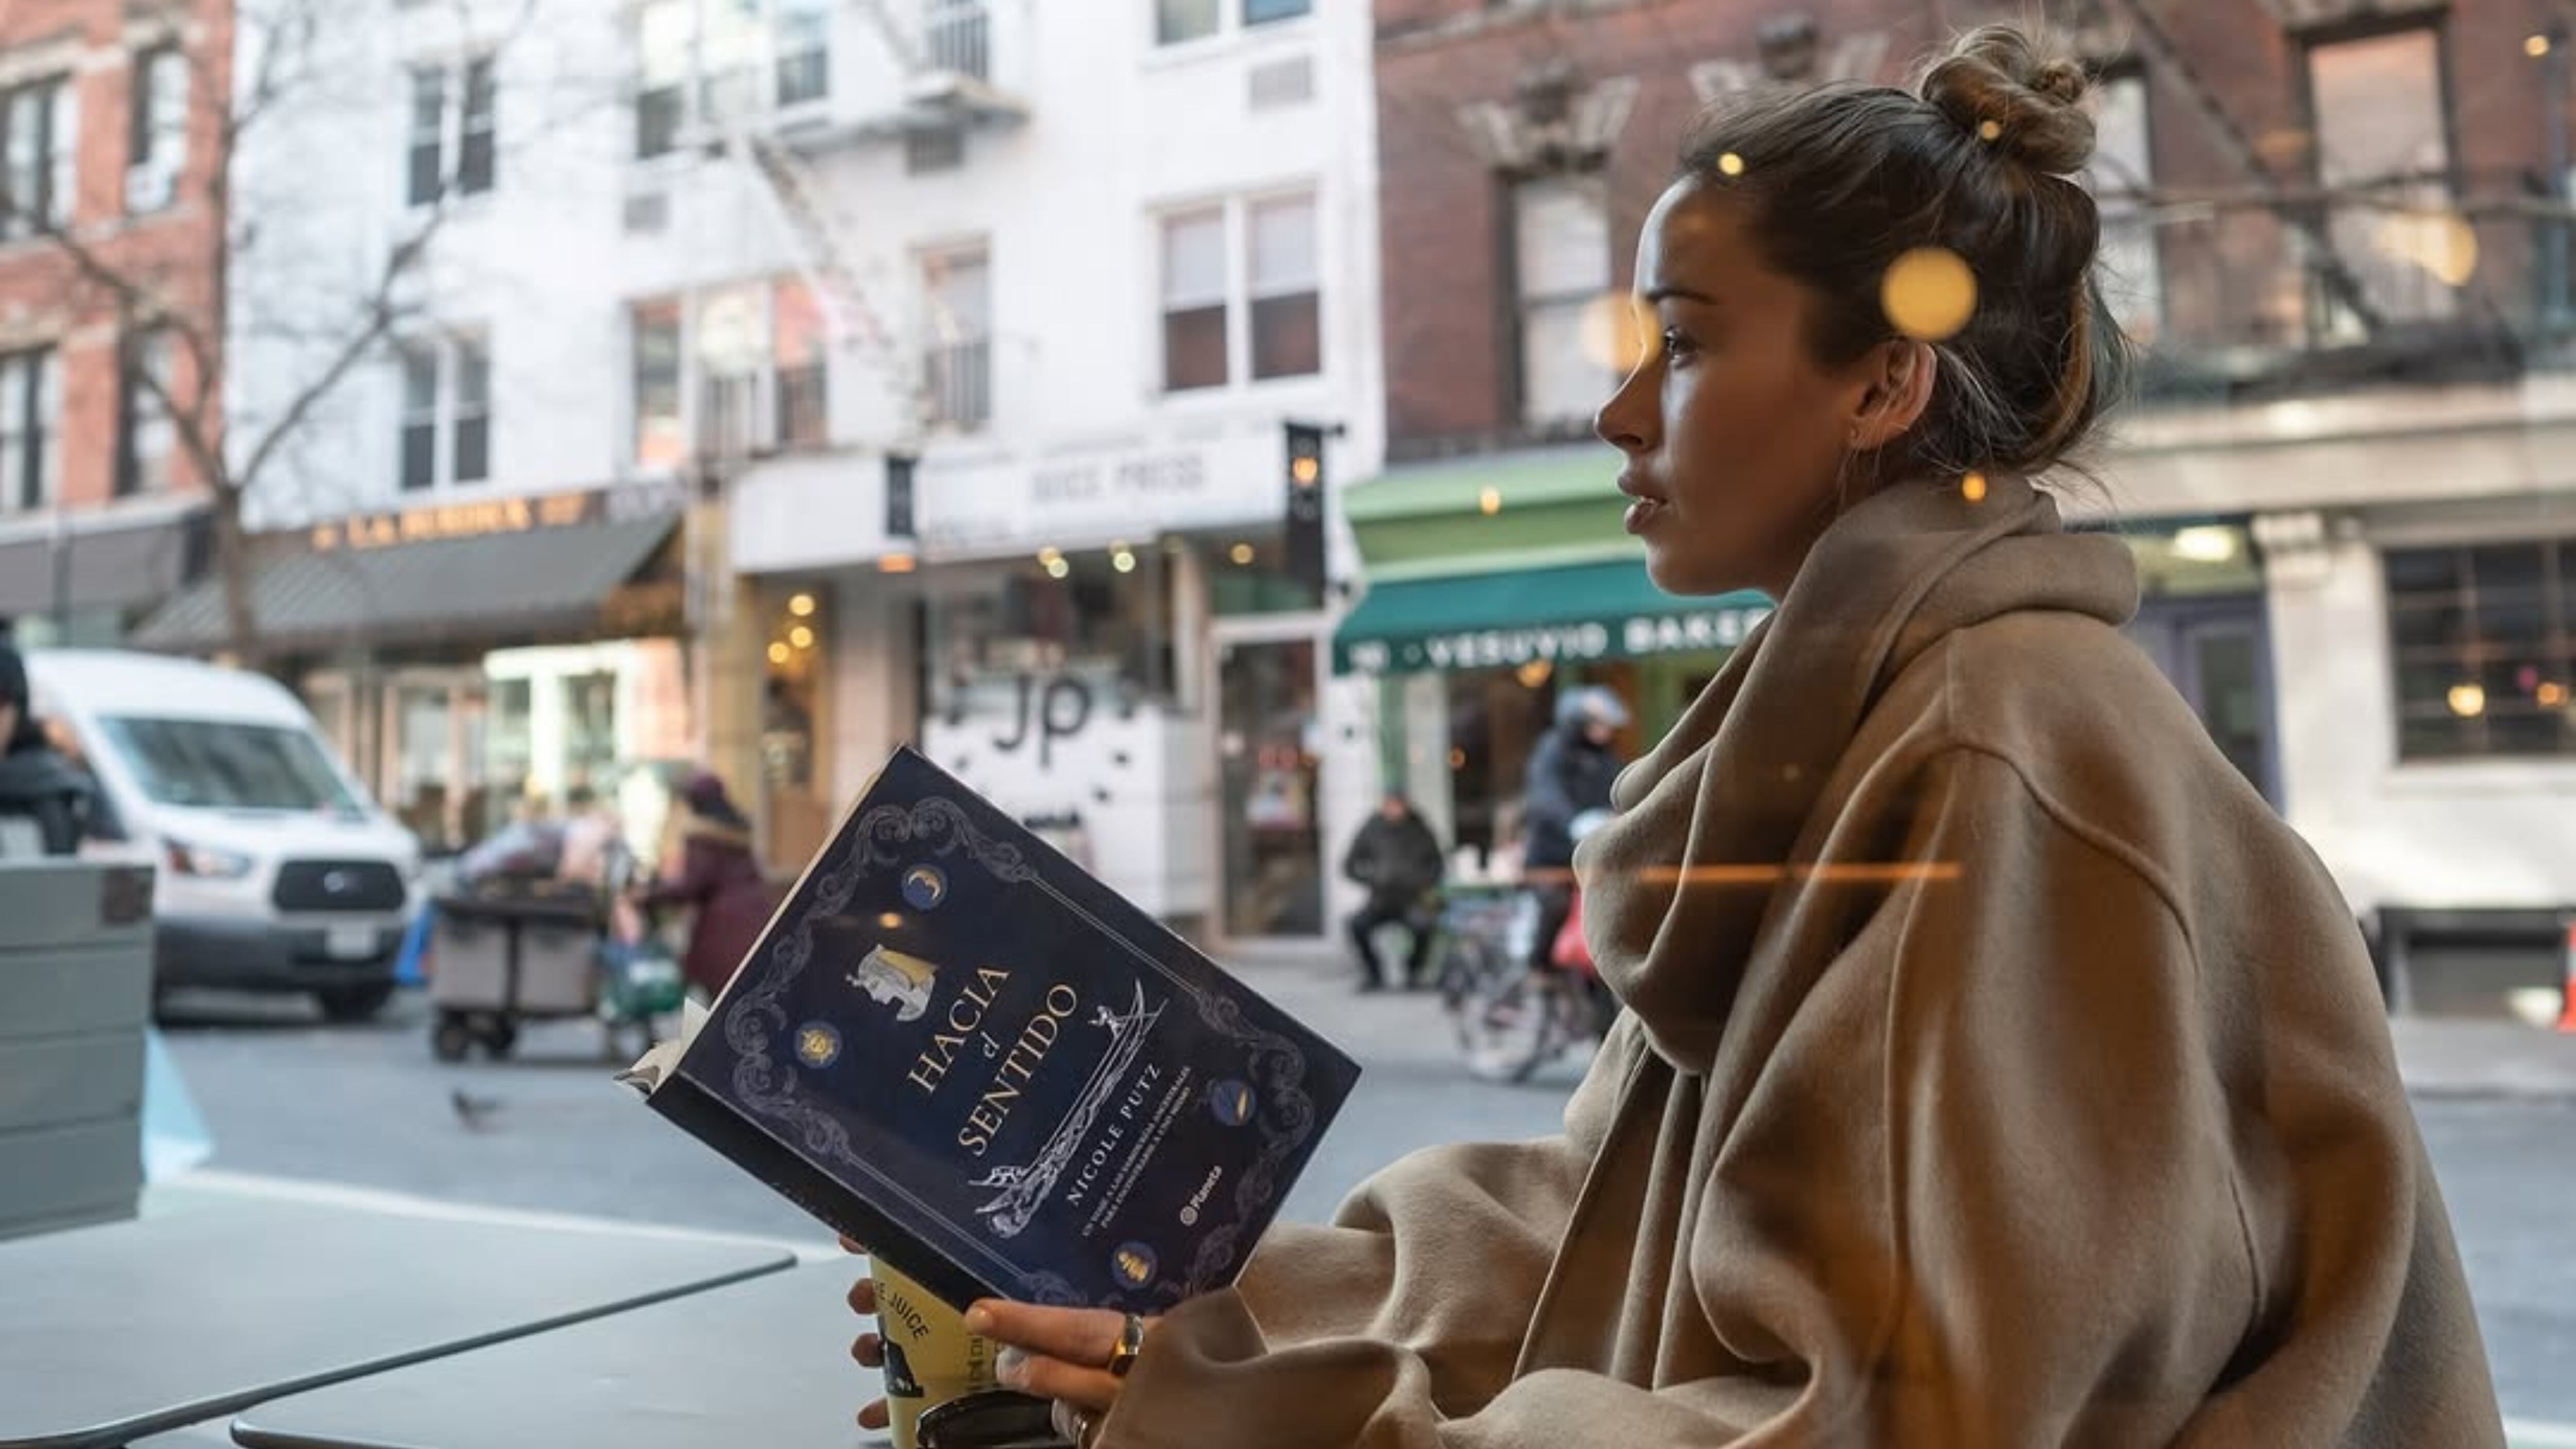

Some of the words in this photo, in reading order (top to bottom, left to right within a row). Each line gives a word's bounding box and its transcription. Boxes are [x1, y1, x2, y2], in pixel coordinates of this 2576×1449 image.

[1428, 622, 1608, 668] VESUVIO
[908, 968, 1009, 1093] HACIA
[979, 1030, 1001, 1059] el
[958, 984, 1076, 1156] SENTIDO
[1066, 1124, 1124, 1206] NICOLE
[1120, 1063, 1160, 1119] PUTZ
[1189, 1165, 1223, 1210] Planeta
[888, 1291, 929, 1340] JUICE
